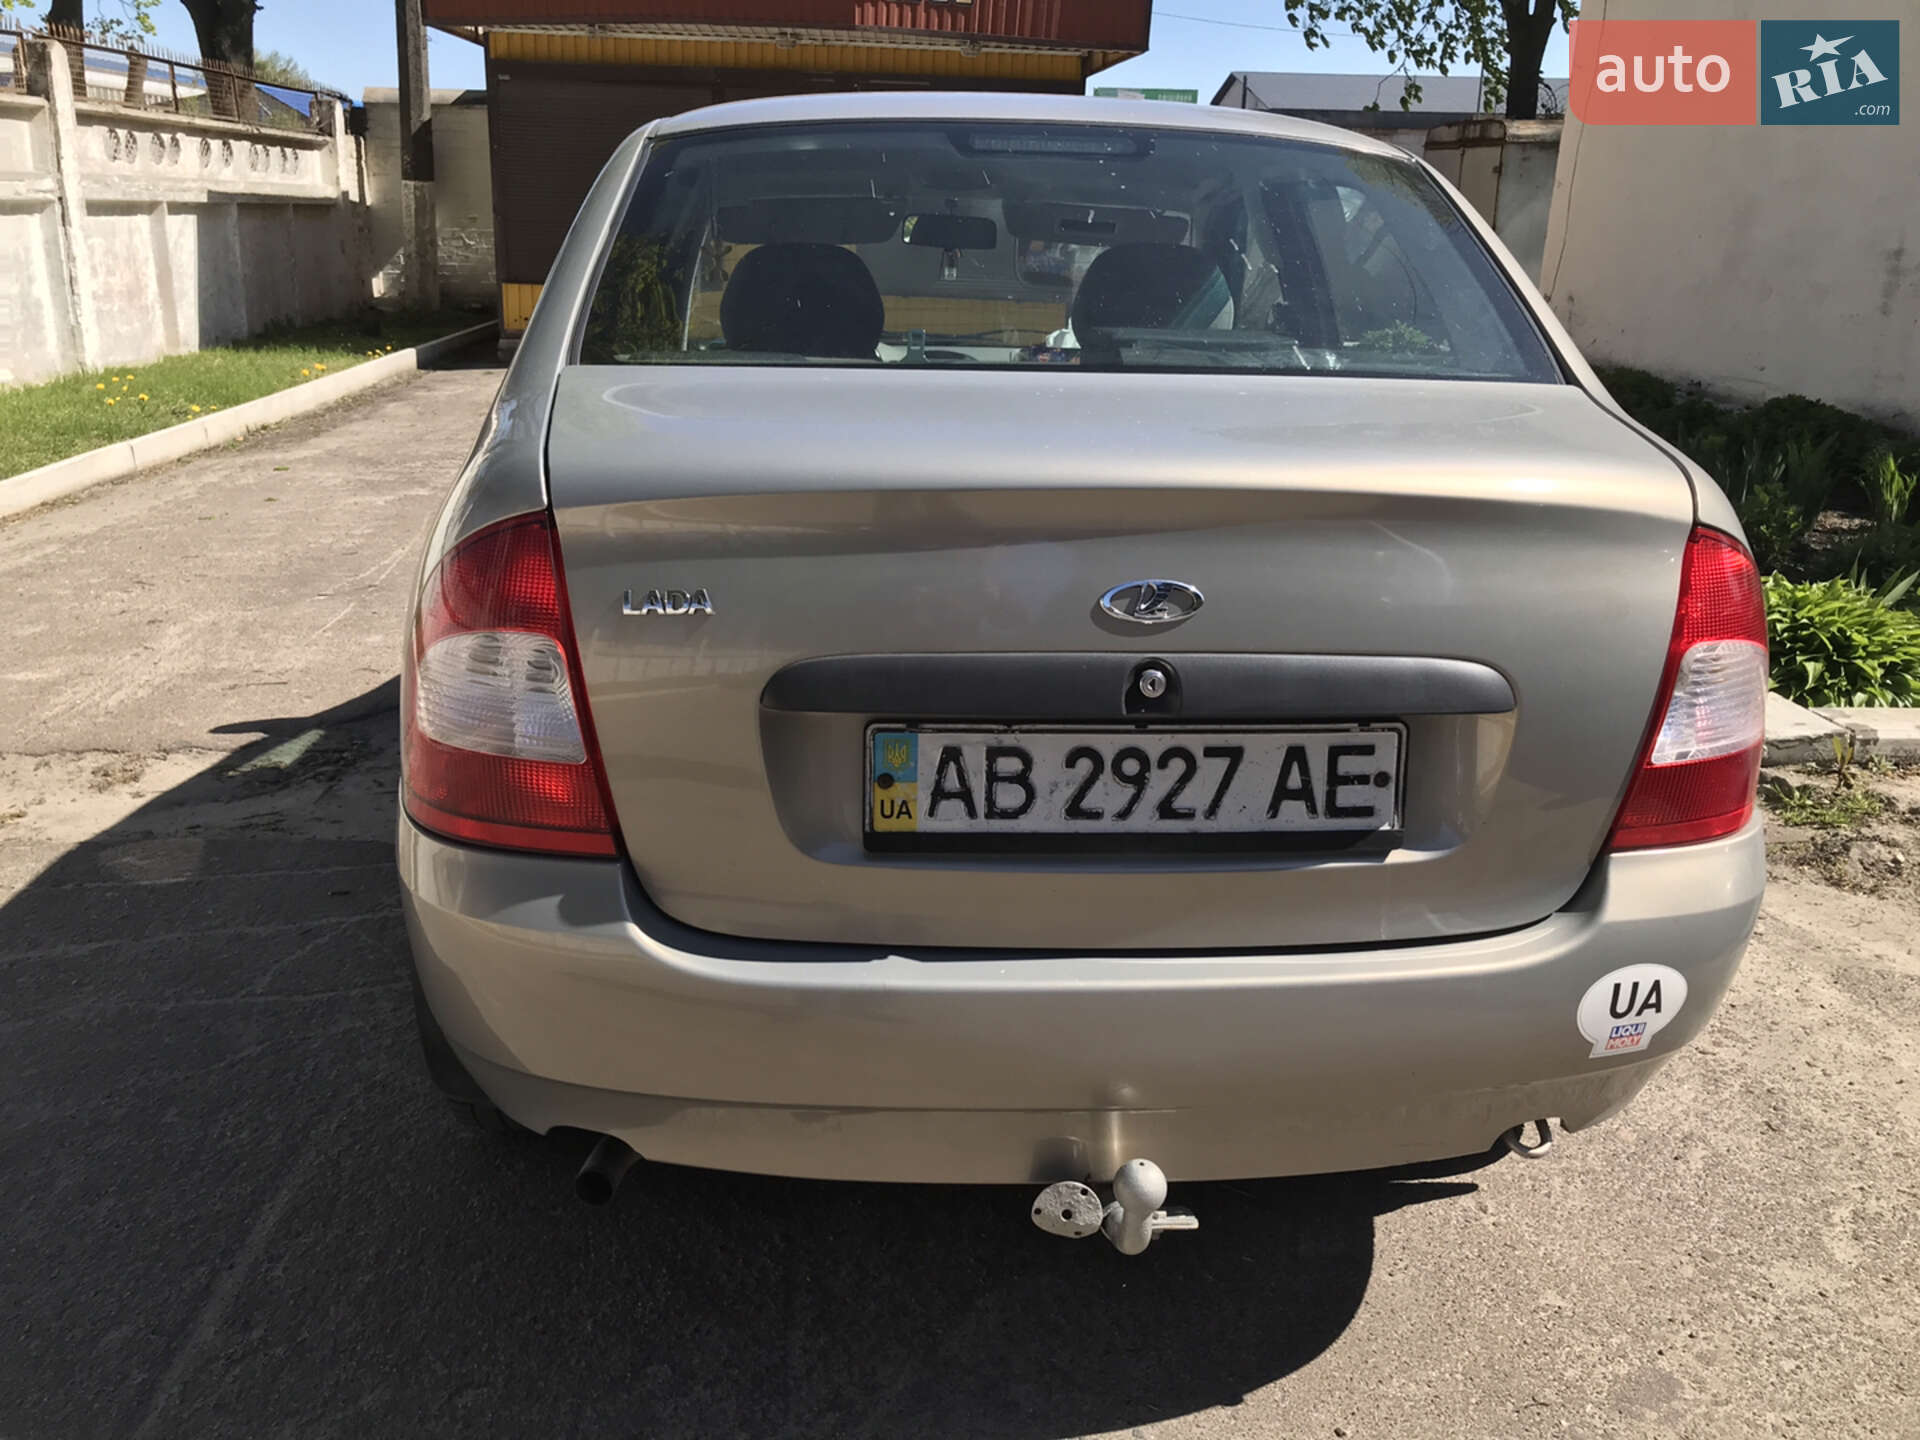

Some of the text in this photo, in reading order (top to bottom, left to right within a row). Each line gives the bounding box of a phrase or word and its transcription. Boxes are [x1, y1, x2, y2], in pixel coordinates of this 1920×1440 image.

[623, 588, 714, 616] LADA
[926, 744, 1376, 821] AB 2927 AE
[880, 799, 913, 820] UA
[1609, 979, 1662, 1020] UA
[1610, 1022, 1647, 1039] LIQUI
